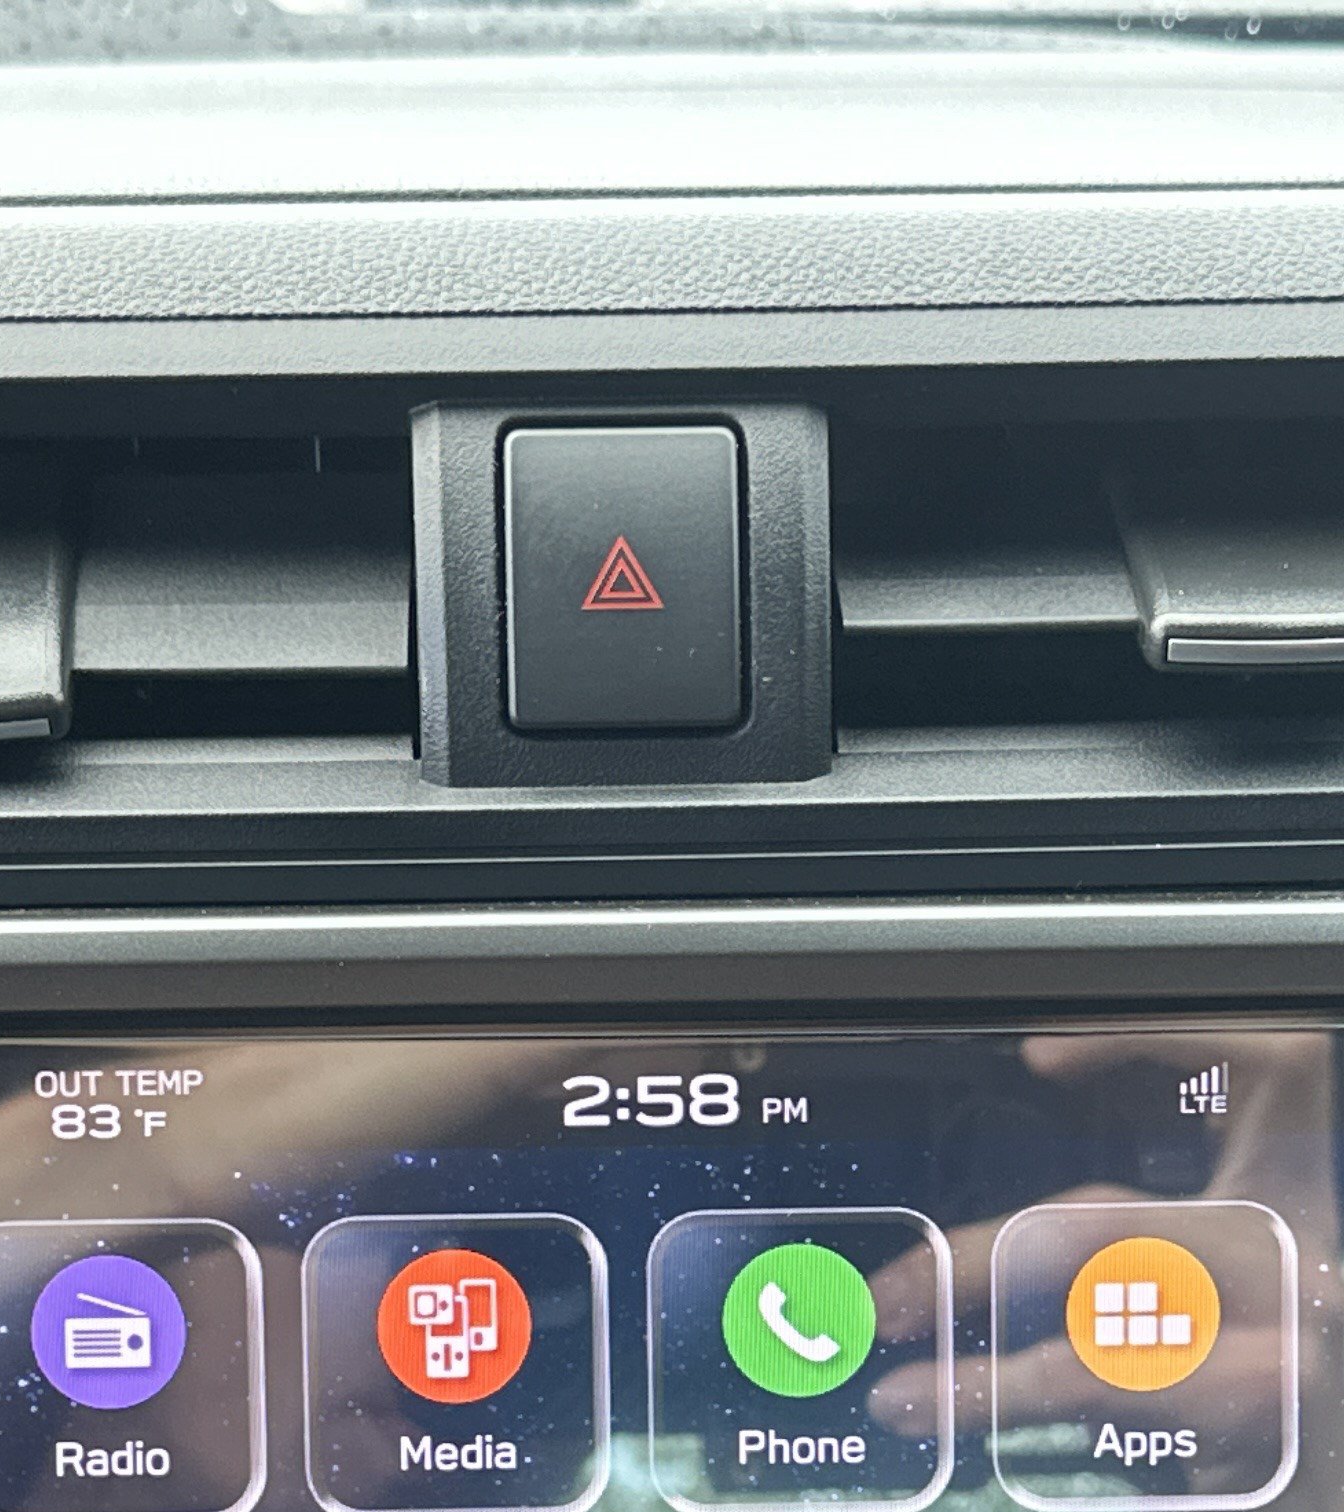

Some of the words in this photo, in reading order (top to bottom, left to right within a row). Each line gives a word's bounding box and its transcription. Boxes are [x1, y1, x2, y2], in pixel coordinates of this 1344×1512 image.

[34, 1070, 100, 1098] OUT
[119, 1069, 204, 1096] TEMP
[562, 1073, 740, 1127] 2:58
[762, 1097, 808, 1124] PM
[51, 1103, 122, 1140] 83
[1180, 1094, 1227, 1114] LTE
[55, 1440, 170, 1477] Radio
[400, 1434, 517, 1471] Media
[738, 1429, 866, 1465] Phone
[1093, 1423, 1198, 1466] Apps
